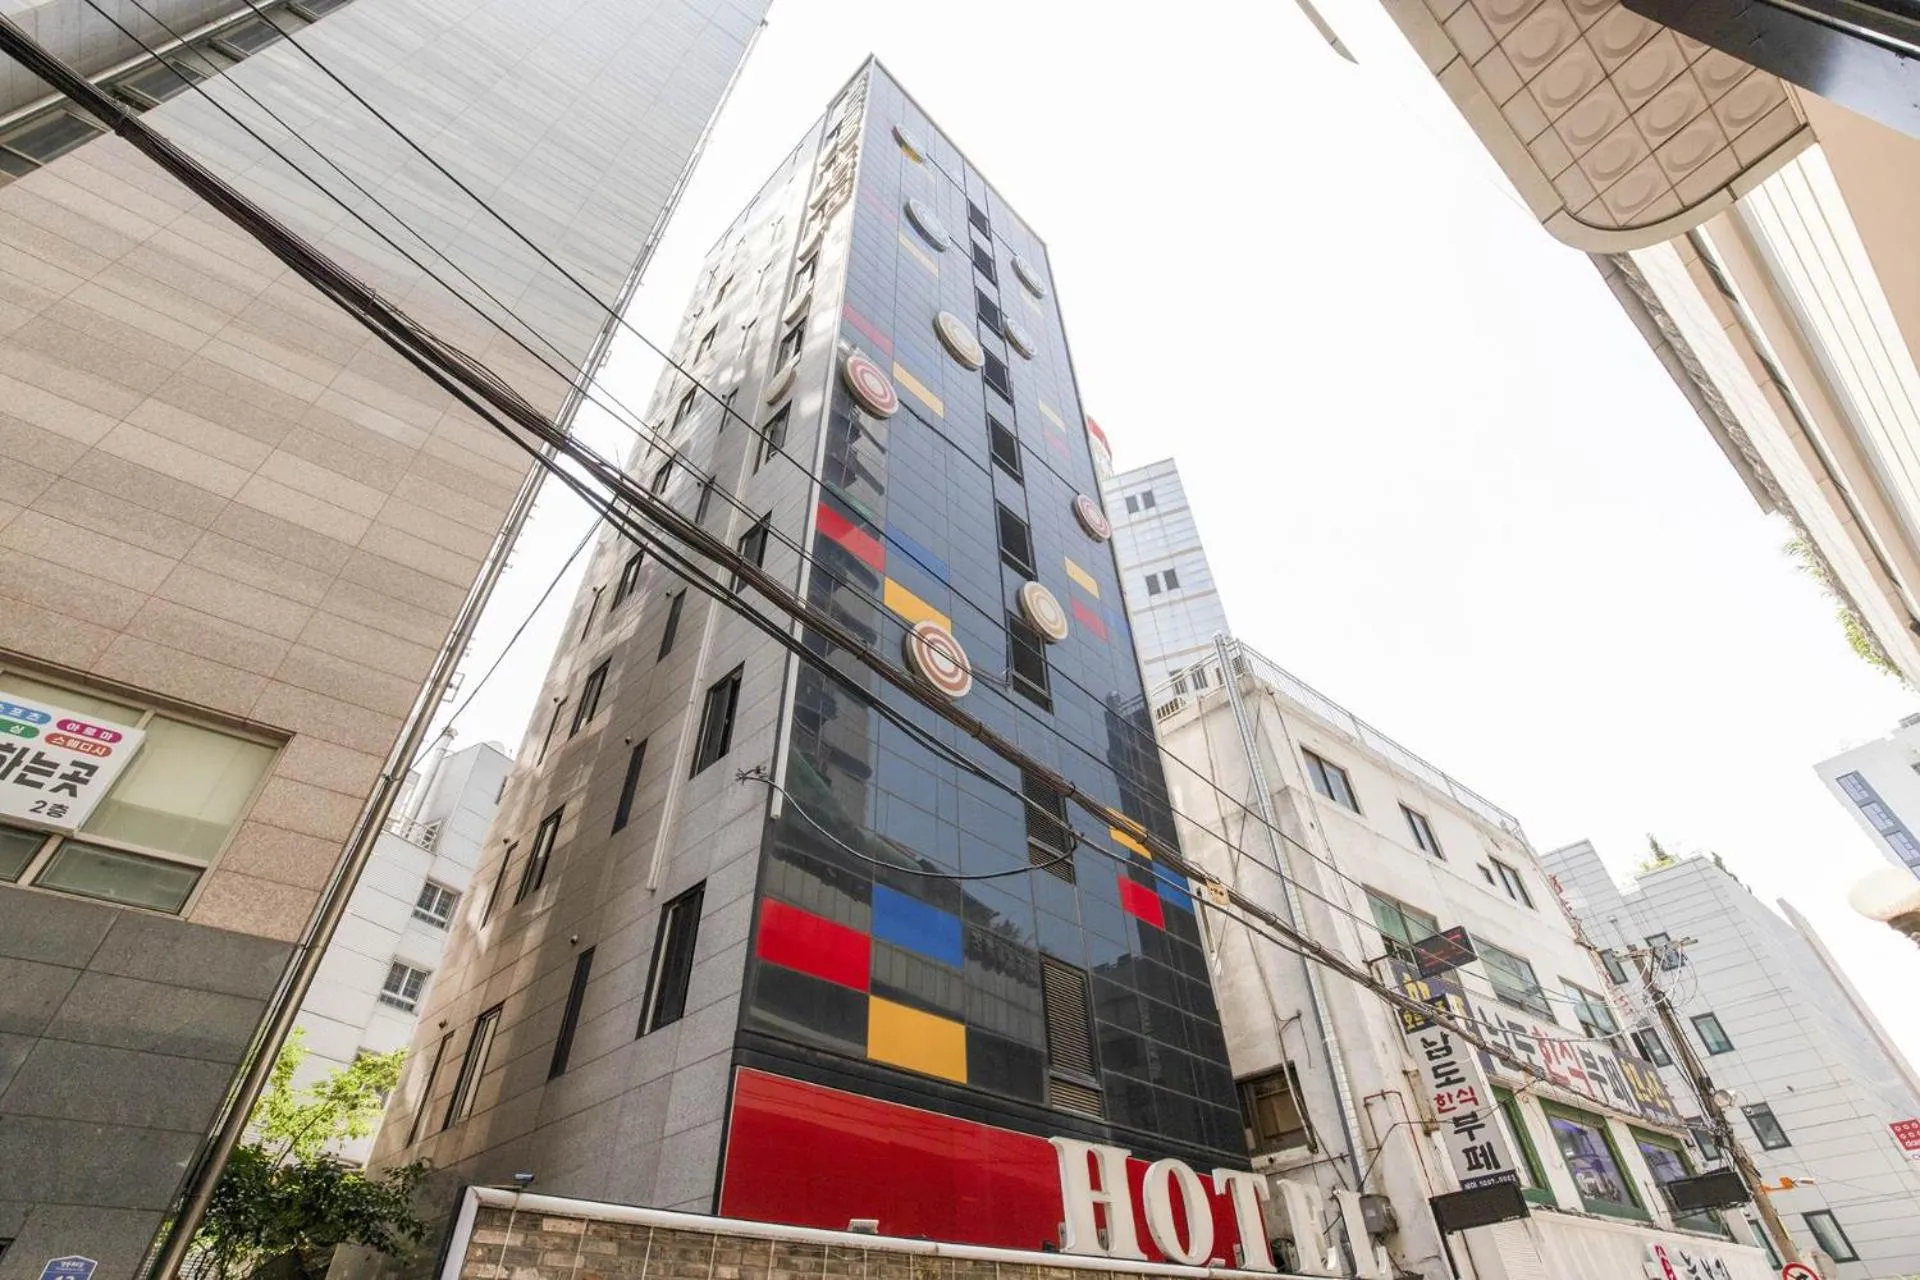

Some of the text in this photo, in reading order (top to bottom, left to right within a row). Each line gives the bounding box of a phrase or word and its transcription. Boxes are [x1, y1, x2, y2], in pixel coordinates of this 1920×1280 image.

[66, 722, 113, 741] 아로마
[29, 800, 70, 819] 2층
[1049, 1135, 1394, 1280] HOTEL
